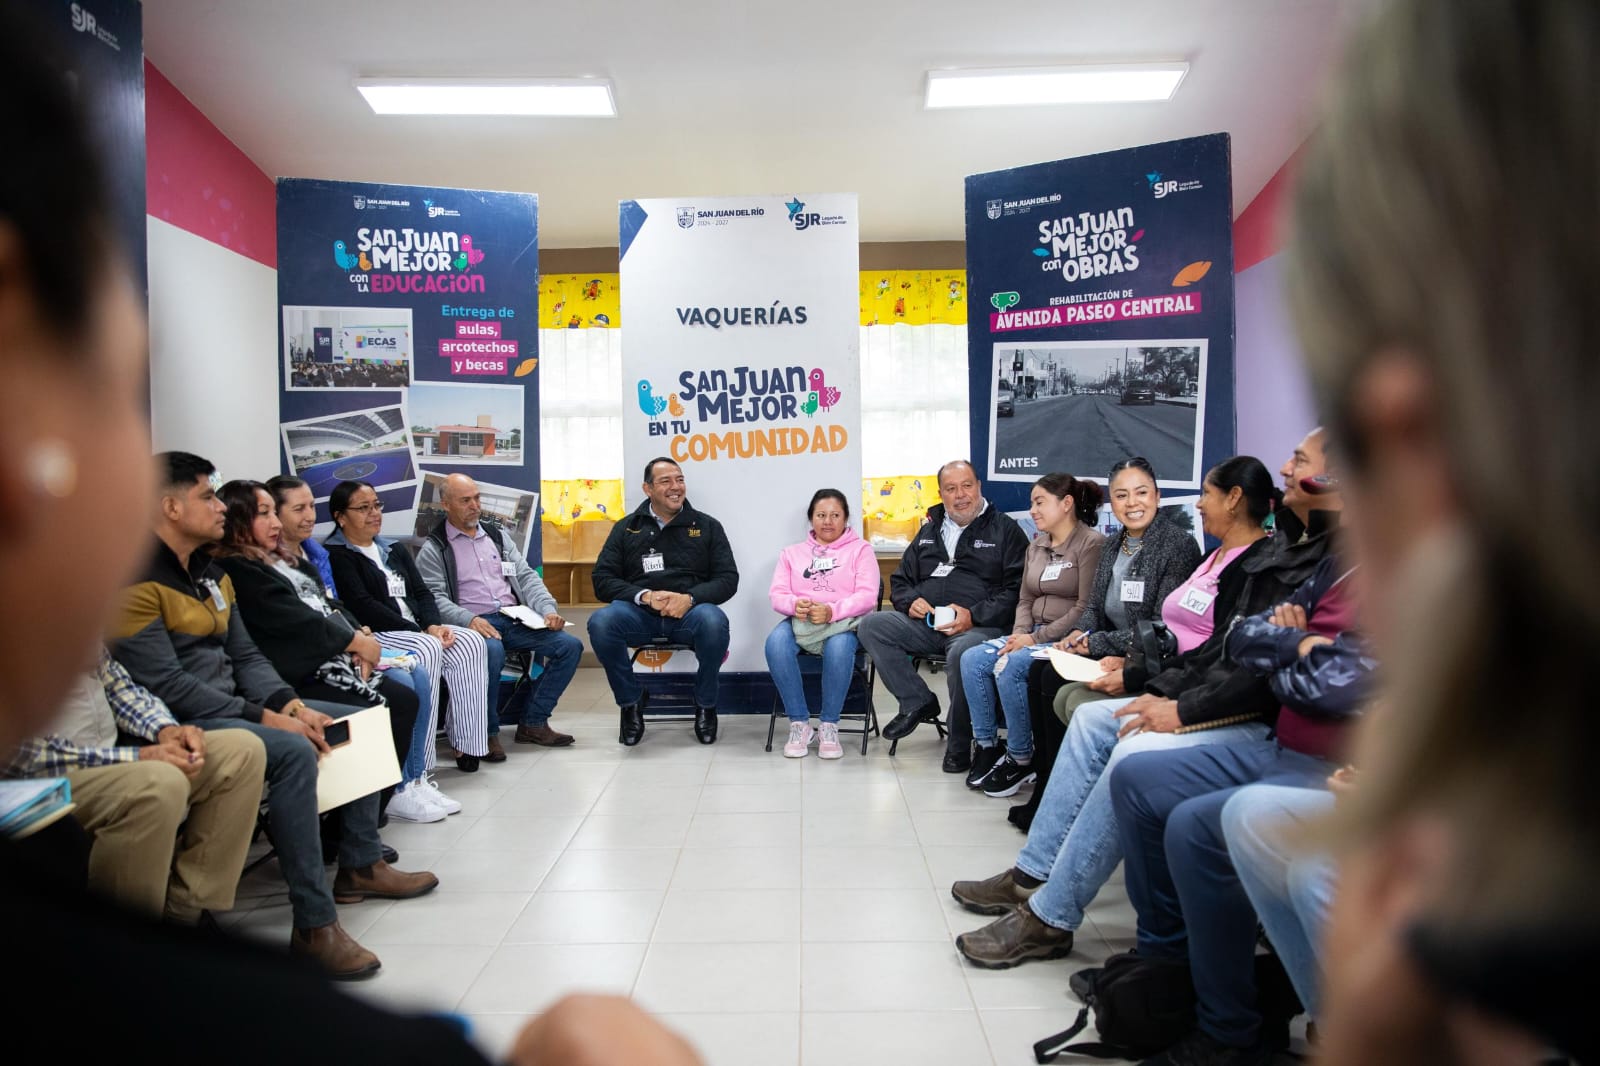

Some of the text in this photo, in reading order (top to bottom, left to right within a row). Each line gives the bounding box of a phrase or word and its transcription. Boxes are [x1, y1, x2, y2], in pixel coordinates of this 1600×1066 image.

[71, 3, 96, 35] SJR
[1154, 180, 1178, 199] SJR
[1004, 201, 1018, 209] SAN
[1020, 198, 1036, 206] JUAN
[1036, 196, 1049, 204] DEL
[428, 206, 444, 218] SJR
[697, 206, 764, 218] SAN JUAN DEL RÍO
[795, 213, 820, 230] SJR
[1051, 231, 1127, 259] MEJOR
[372, 247, 452, 272] MEJOR
[1062, 245, 1140, 282] OBRAS
[358, 284, 369, 293] LA
[1050, 289, 1134, 306] REHABILITACIÓN DE
[442, 305, 515, 320] Entrega de
[676, 300, 808, 328] VAQUERÍAS
[996, 295, 1195, 330] AVENIDA PASEO CENTRAL
[458, 324, 498, 337] aulas,
[442, 341, 516, 354] arcotechos
[454, 358, 504, 372] y becas
[698, 392, 798, 425] MEJOR
[648, 420, 691, 436] EN TU
[670, 424, 848, 464] COMUNIDAD
[1000, 457, 1038, 469] ANTES
